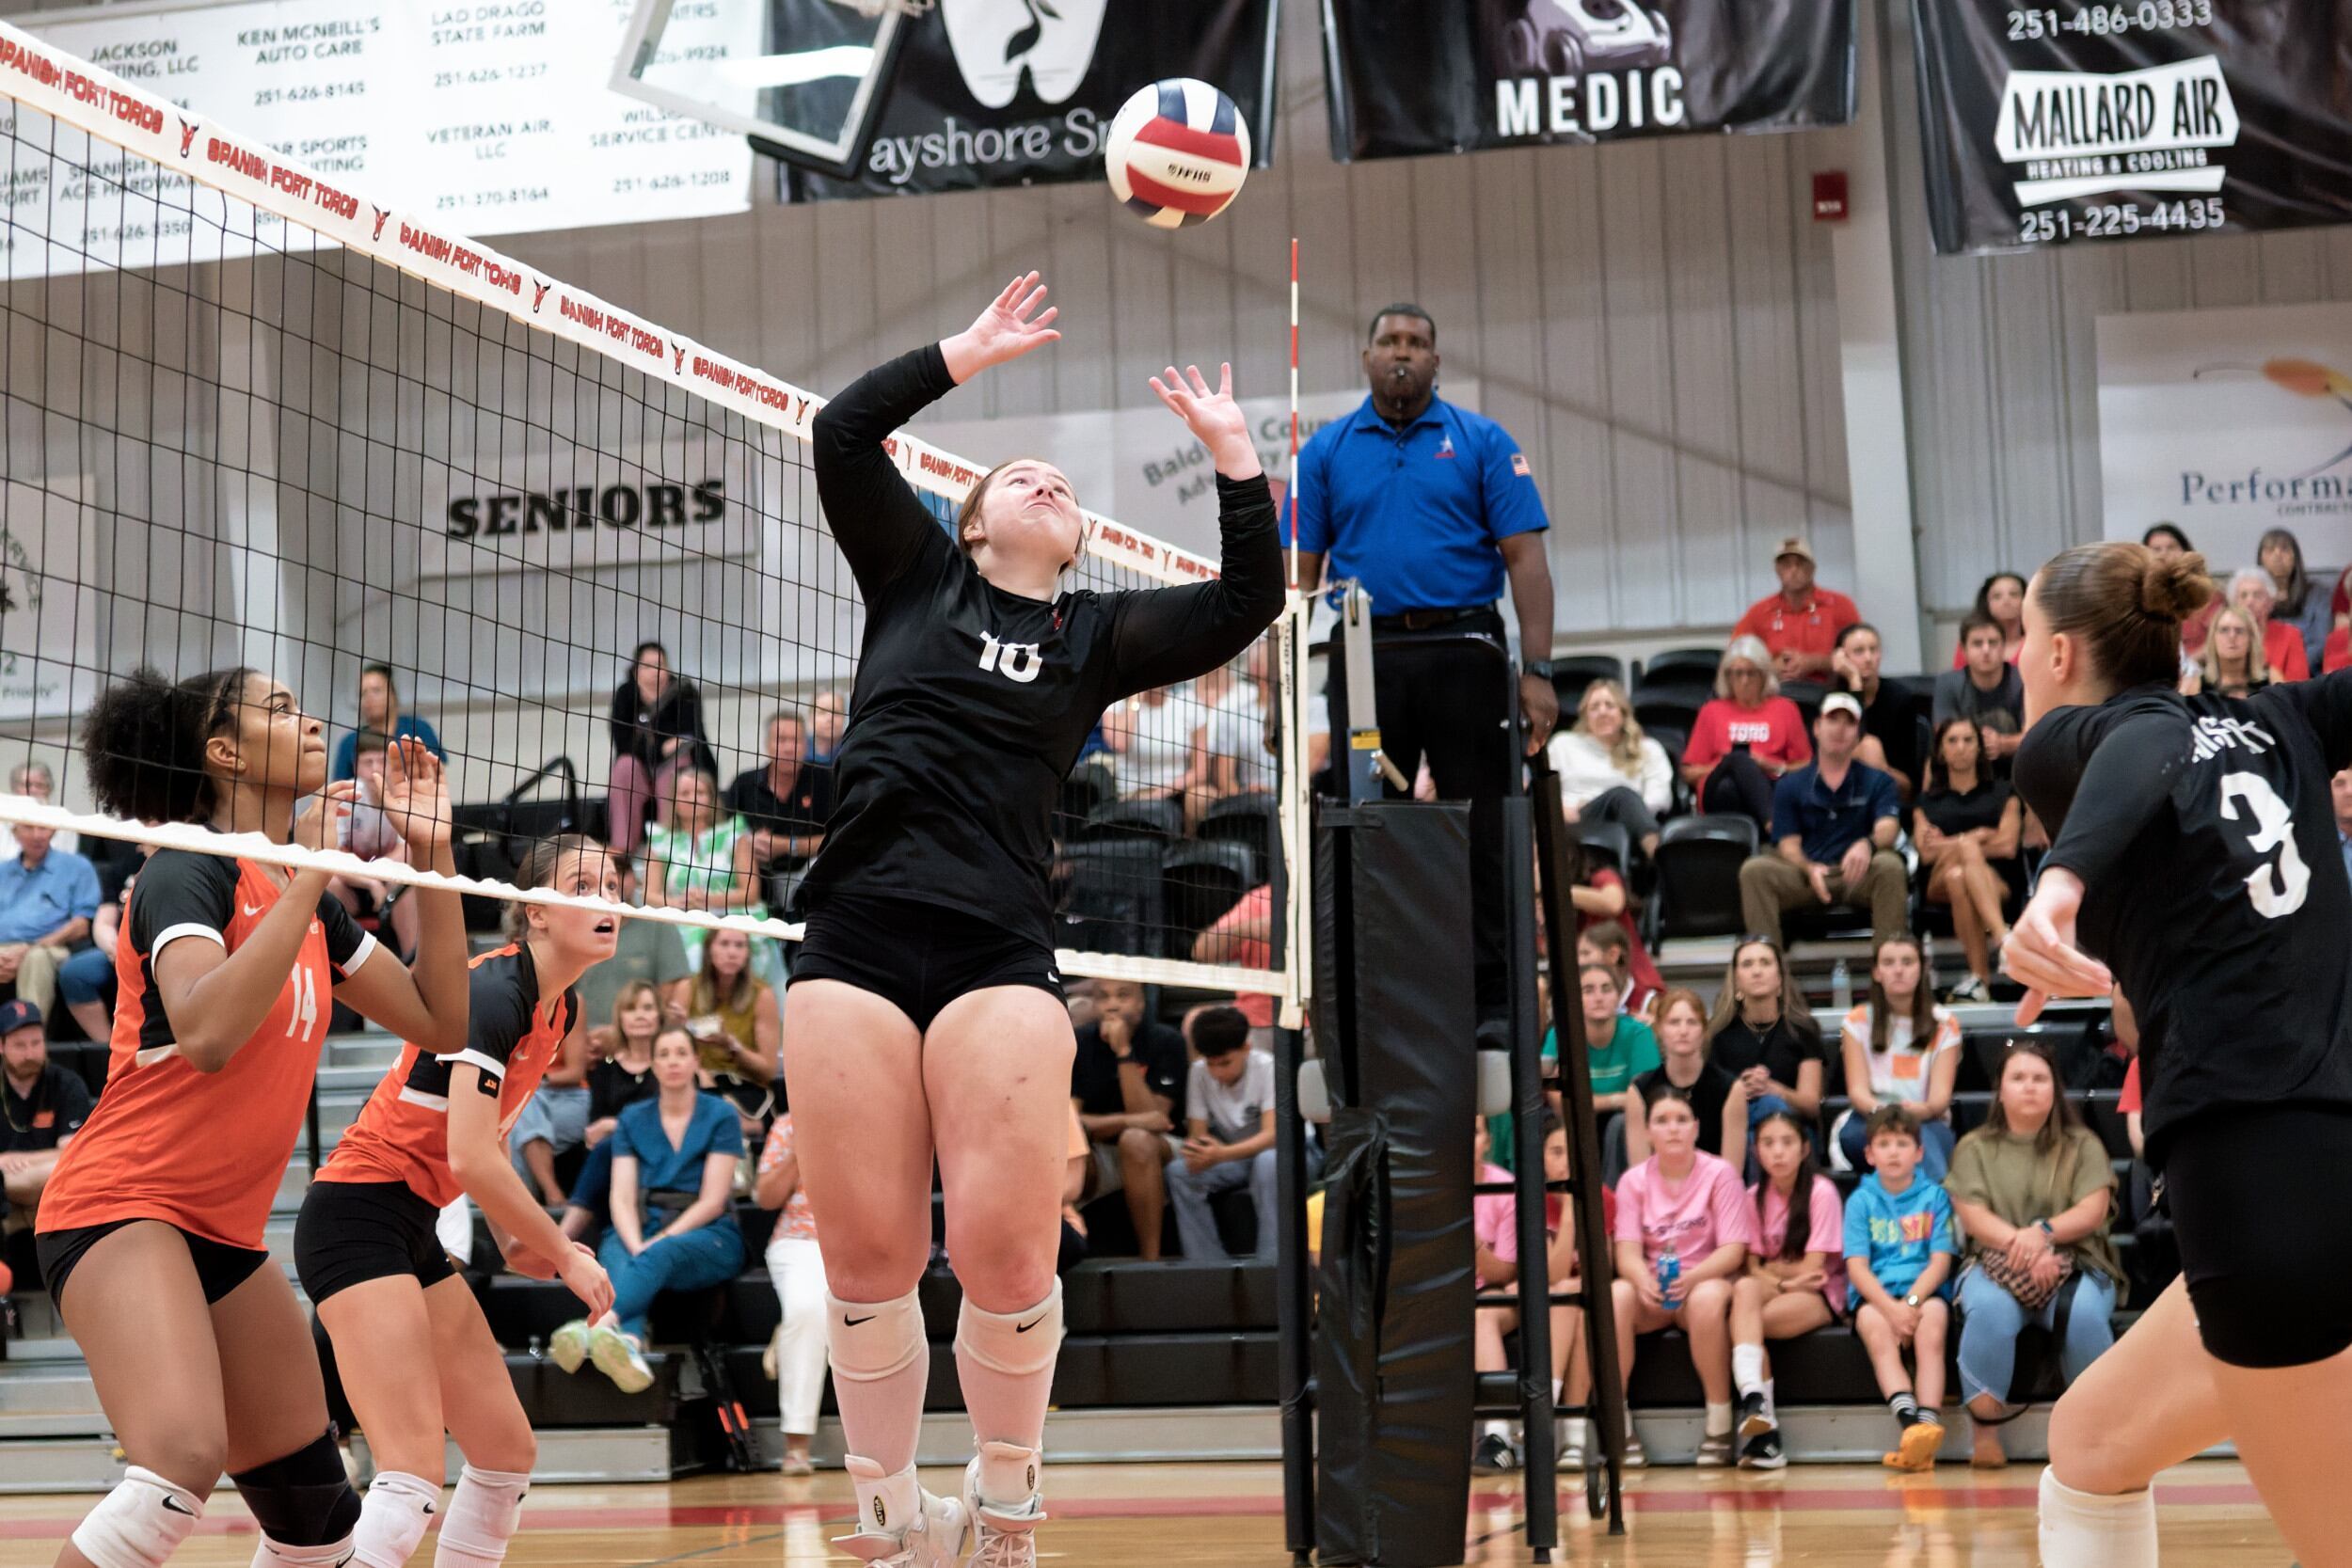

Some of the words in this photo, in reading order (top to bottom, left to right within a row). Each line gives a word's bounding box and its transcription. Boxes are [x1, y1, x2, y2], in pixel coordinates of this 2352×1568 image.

[475, 0, 545, 21] DRAGO
[2006, 0, 2214, 41] 251-486-0333
[90, 40, 178, 61] JACKSON
[237, 28, 277, 46] KEN
[431, 26, 485, 46] STATE
[492, 21, 546, 39] FARM
[167, 55, 199, 74] LLC
[256, 44, 307, 64] AUTO
[313, 39, 362, 58] CARE
[1495, 66, 1685, 137] MEDIC
[2013, 82, 2156, 151] MALLARD
[2173, 75, 2223, 138] AIR
[426, 122, 513, 144] VETERAN
[589, 126, 668, 149] SERVICE
[868, 116, 1051, 184] ayshore
[475, 142, 506, 161] LLC
[2026, 155, 2106, 181] HEATING
[2126, 147, 2208, 173] COOLING
[270, 166, 313, 200] FORT
[314, 182, 358, 220] TOROS
[2019, 197, 2226, 244] 251-225-4435
[692, 356, 736, 389] SPANISH
[447, 478, 725, 541] SENIORS
[977, 629, 1043, 684] 10
[2219, 770, 2312, 919] 3
[285, 961, 318, 1043] 14
